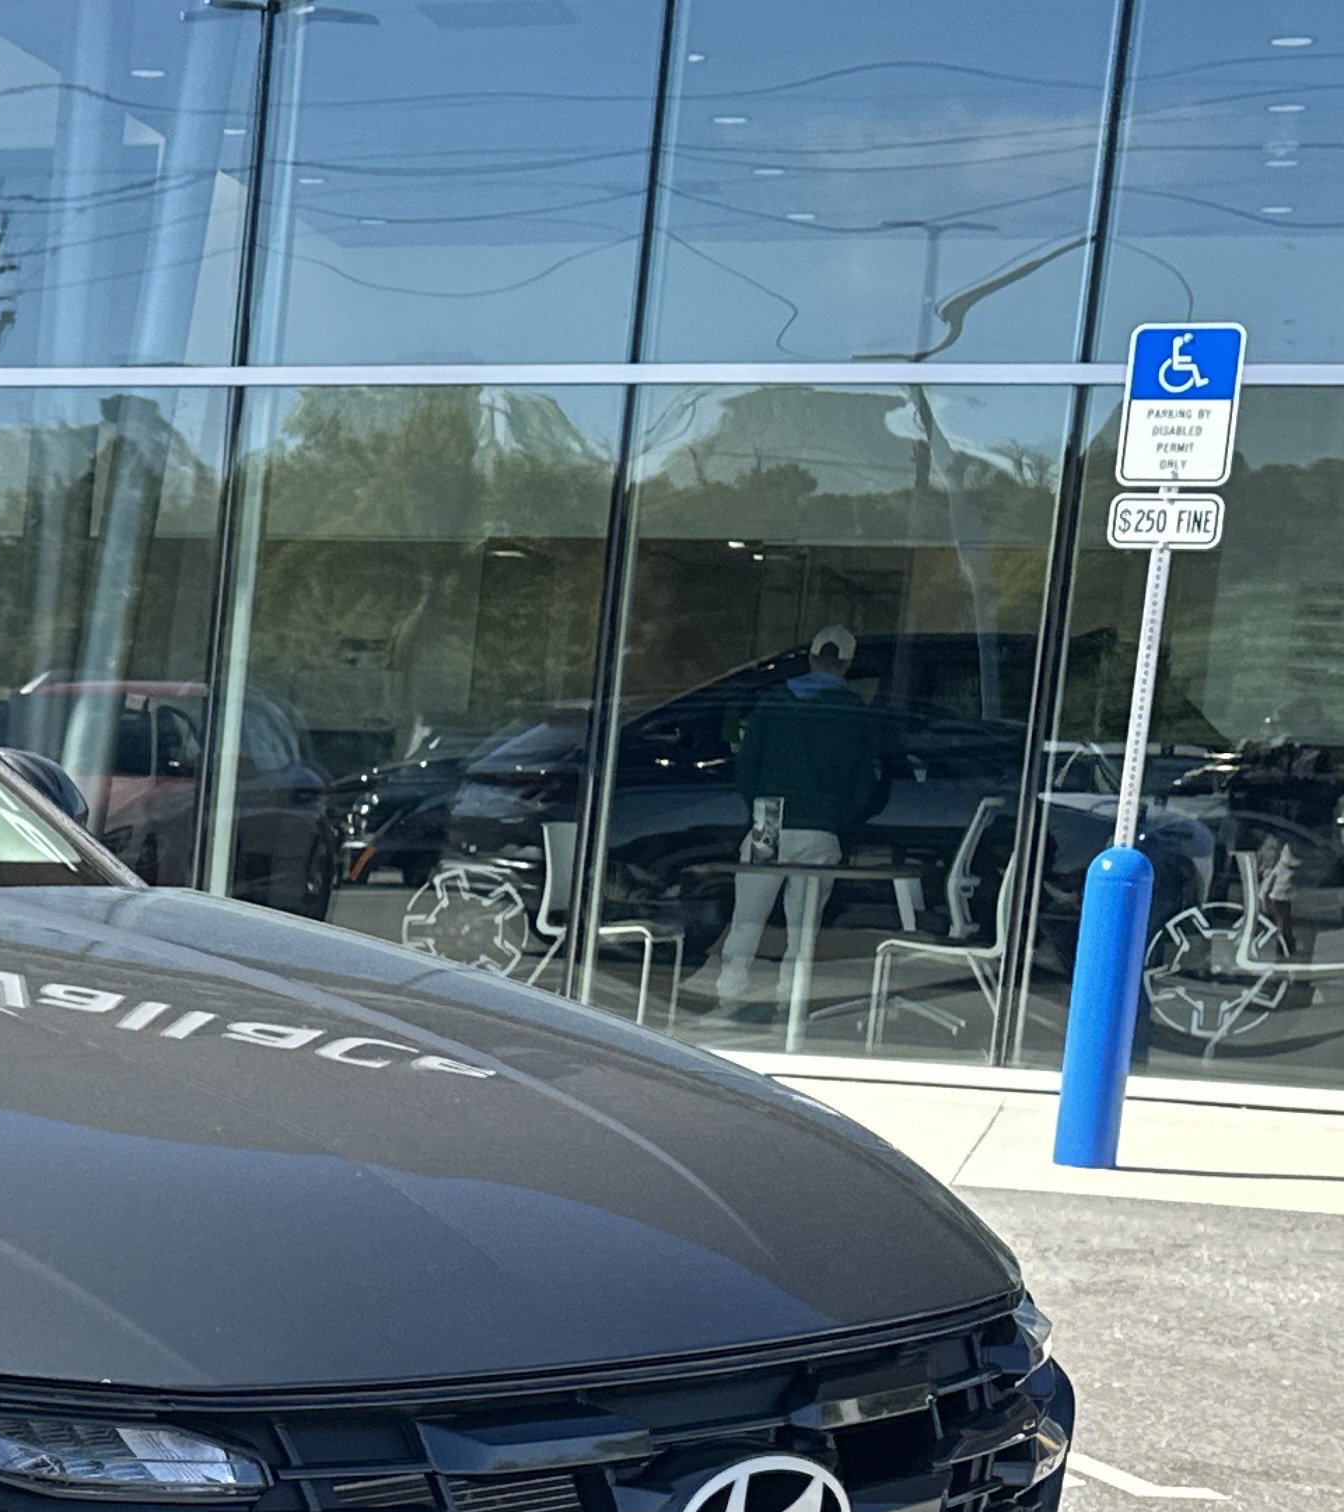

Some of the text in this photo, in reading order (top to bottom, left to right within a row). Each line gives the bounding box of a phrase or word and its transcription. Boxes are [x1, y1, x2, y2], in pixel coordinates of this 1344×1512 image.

[1147, 408, 1212, 420] PARKING BY
[1152, 425, 1203, 437] DISABLED
[1156, 442, 1194, 454] PERMIT
[1159, 459, 1188, 471] ONLY
[1118, 508, 1213, 535] $250 FINE
